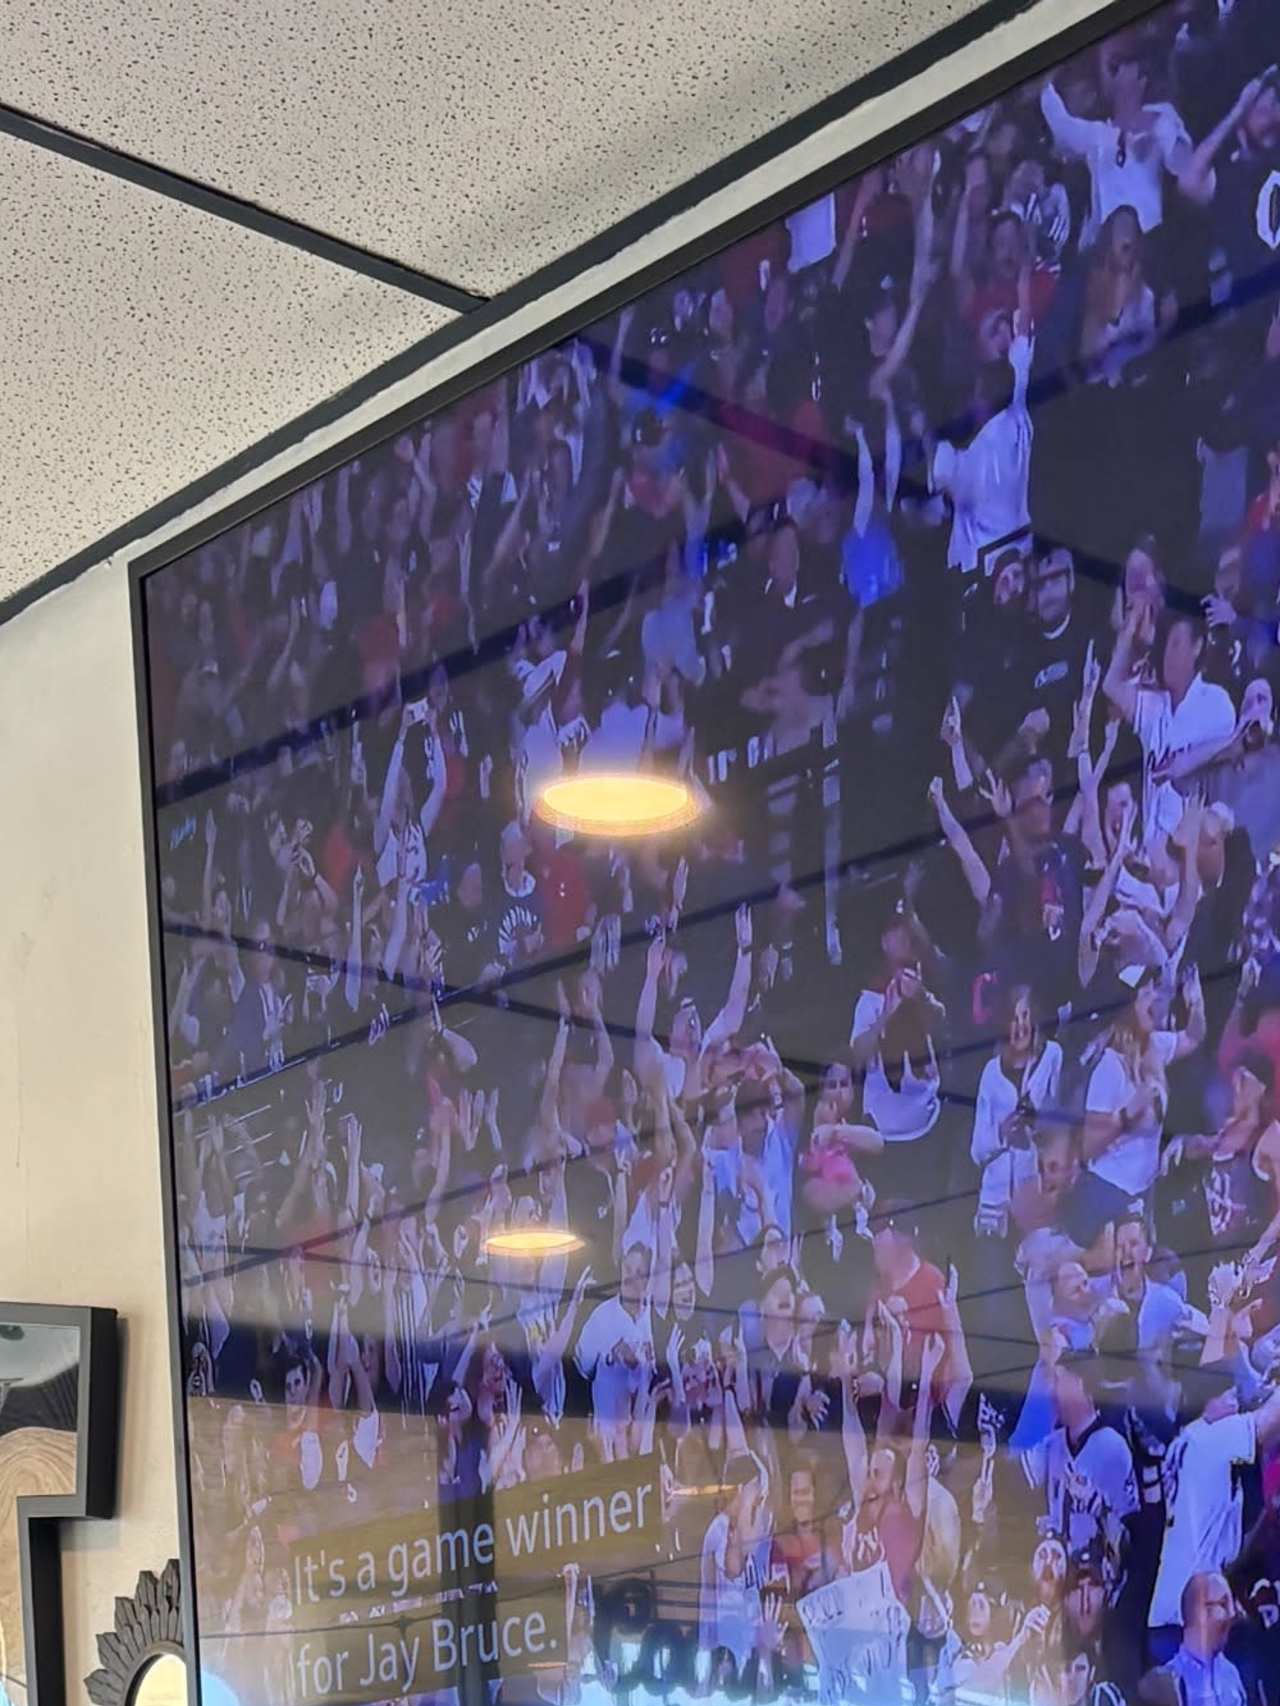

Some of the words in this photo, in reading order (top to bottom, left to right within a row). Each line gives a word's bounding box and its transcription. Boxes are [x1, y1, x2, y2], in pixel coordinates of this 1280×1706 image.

[294, 1548, 346, 1606] It's
[357, 1554, 376, 1591] a
[389, 1523, 494, 1598] game
[296, 1644, 348, 1699] for
[359, 1633, 421, 1692] Jay
[433, 1607, 559, 1675] Bruce.
